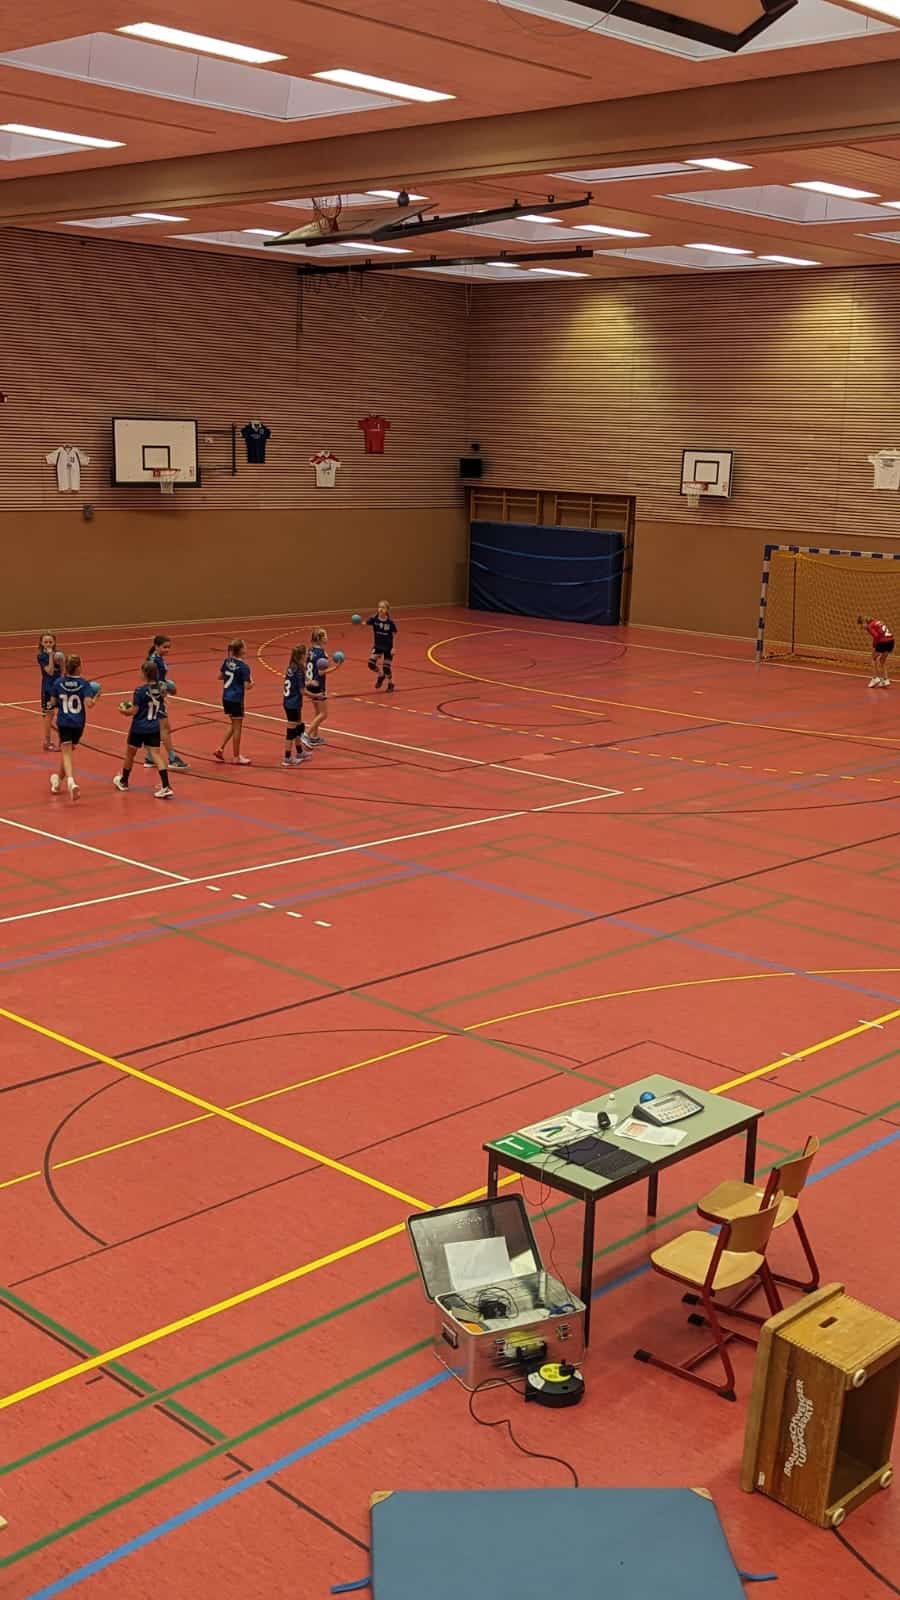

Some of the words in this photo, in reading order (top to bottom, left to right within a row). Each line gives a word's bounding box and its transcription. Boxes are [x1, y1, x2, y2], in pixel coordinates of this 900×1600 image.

[223, 670, 235, 689] 7
[283, 679, 292, 697] 3
[59, 694, 82, 714] 10
